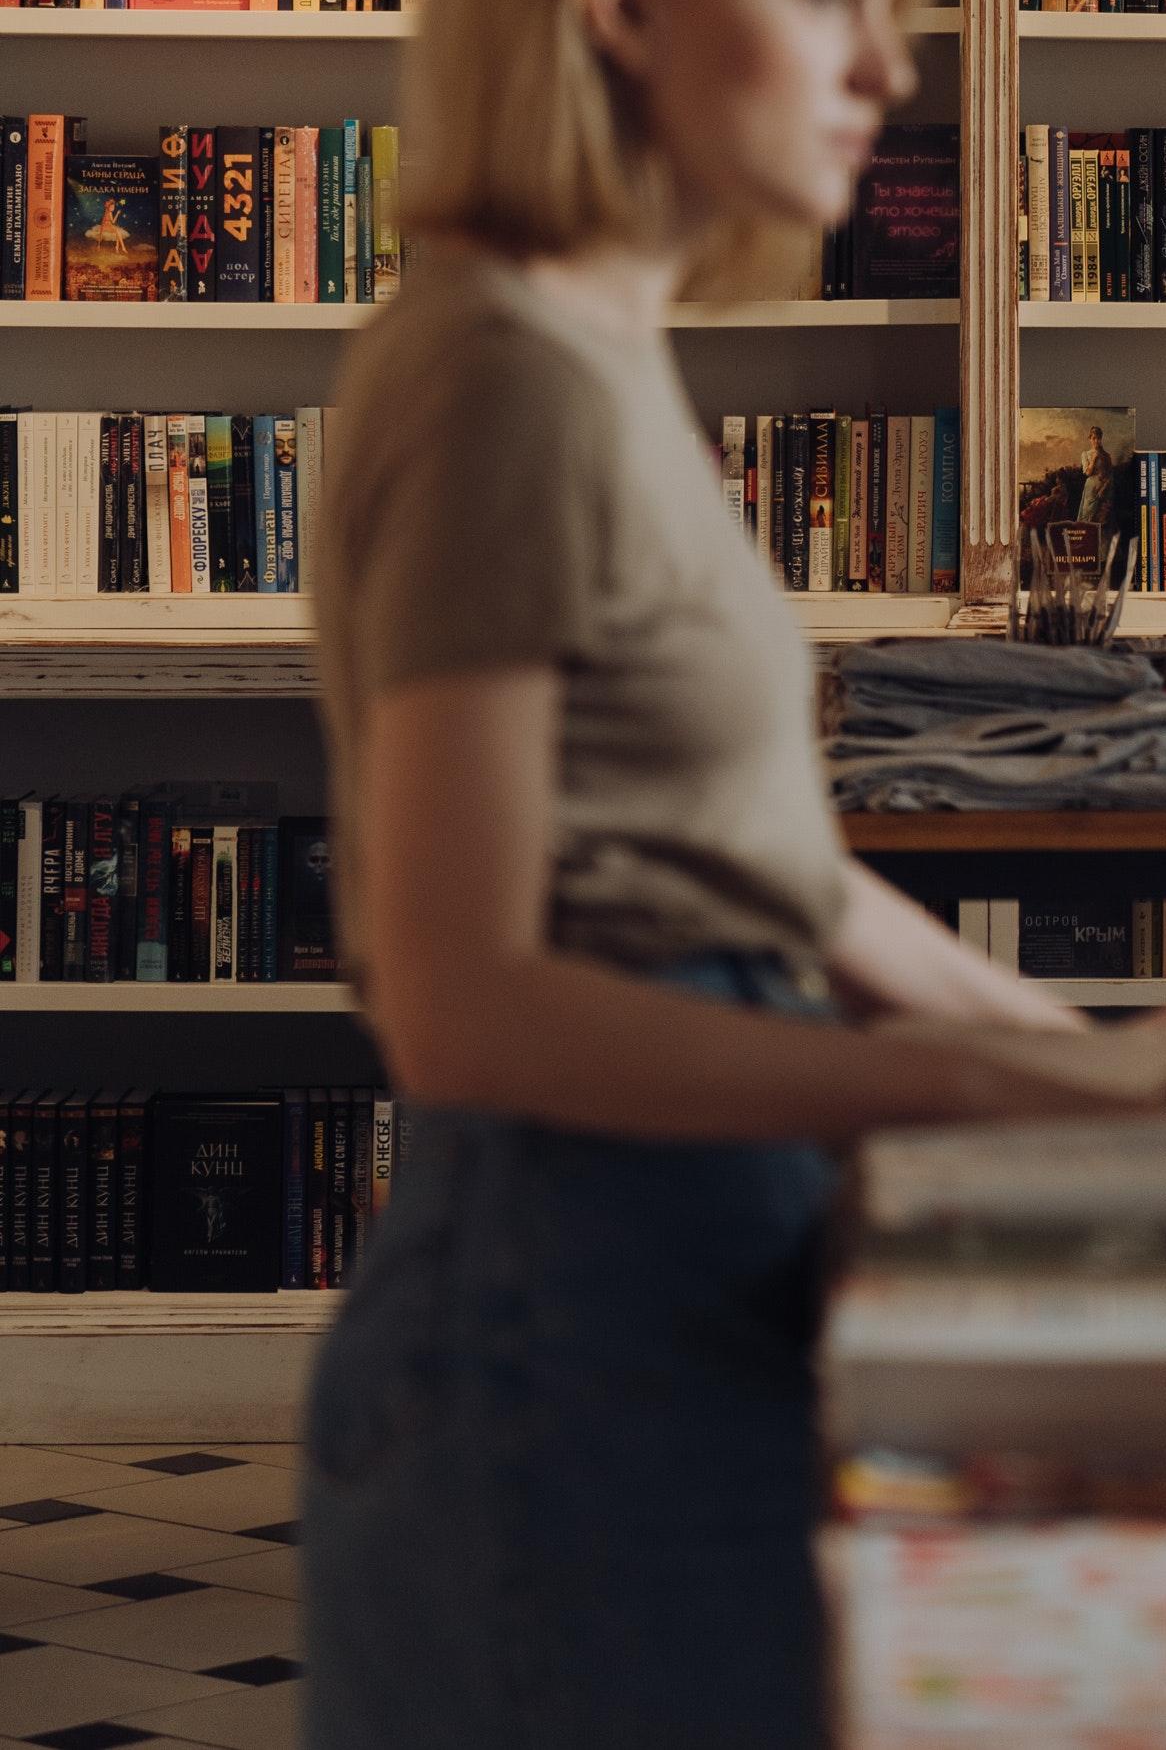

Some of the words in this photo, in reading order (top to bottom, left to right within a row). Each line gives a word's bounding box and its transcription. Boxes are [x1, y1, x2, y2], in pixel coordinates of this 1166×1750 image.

[1056, 141, 1065, 186] ЖЕНЩИНЫ
[1072, 164, 1082, 200] ОРУЭЛЛ
[1086, 164, 1096, 200] ОРУЭЛЛ
[1140, 164, 1149, 192] ДЖЕЙН
[224, 154, 252, 241] 4321
[279, 158, 290, 239] СИРЕНА
[1073, 255, 1083, 287] 1984
[1086, 255, 1097, 287] 1984
[148, 430, 164, 471] ПЛАЧ
[815, 422, 828, 497] СИВИЛЛА
[918, 430, 928, 476] ЛАРОУЗ
[942, 433, 955, 502] КОМПАС
[916, 491, 927, 536] ЭРДРИЧ
[191, 507, 207, 572] ФЛОРЕСКУ
[263, 509, 275, 583] Флэнаган
[896, 535, 905, 559] ДОМ
[915, 541, 925, 579] ЛУИЗА
[93, 811, 112, 842] ЛГУ
[75, 850, 85, 874] ДОМЕ
[91, 897, 111, 956] ИНОГДА
[14, 1166, 27, 1206] КУНЦ
[38, 1167, 50, 1207] КУНЦ
[66, 1167, 79, 1207] КУНЦ
[96, 1166, 109, 1206] КУНЦ
[123, 1165, 136, 1205] КУНЦ
[191, 1162, 243, 1176] КУНЦ
[377, 1165, 389, 1179] Ю
[14, 1213, 25, 1246] ДИН
[38, 1214, 49, 1247] ДИН
[66, 1215, 78, 1248] ДИН
[96, 1213, 108, 1246] ДИН
[123, 1212, 135, 1244] ДИН
